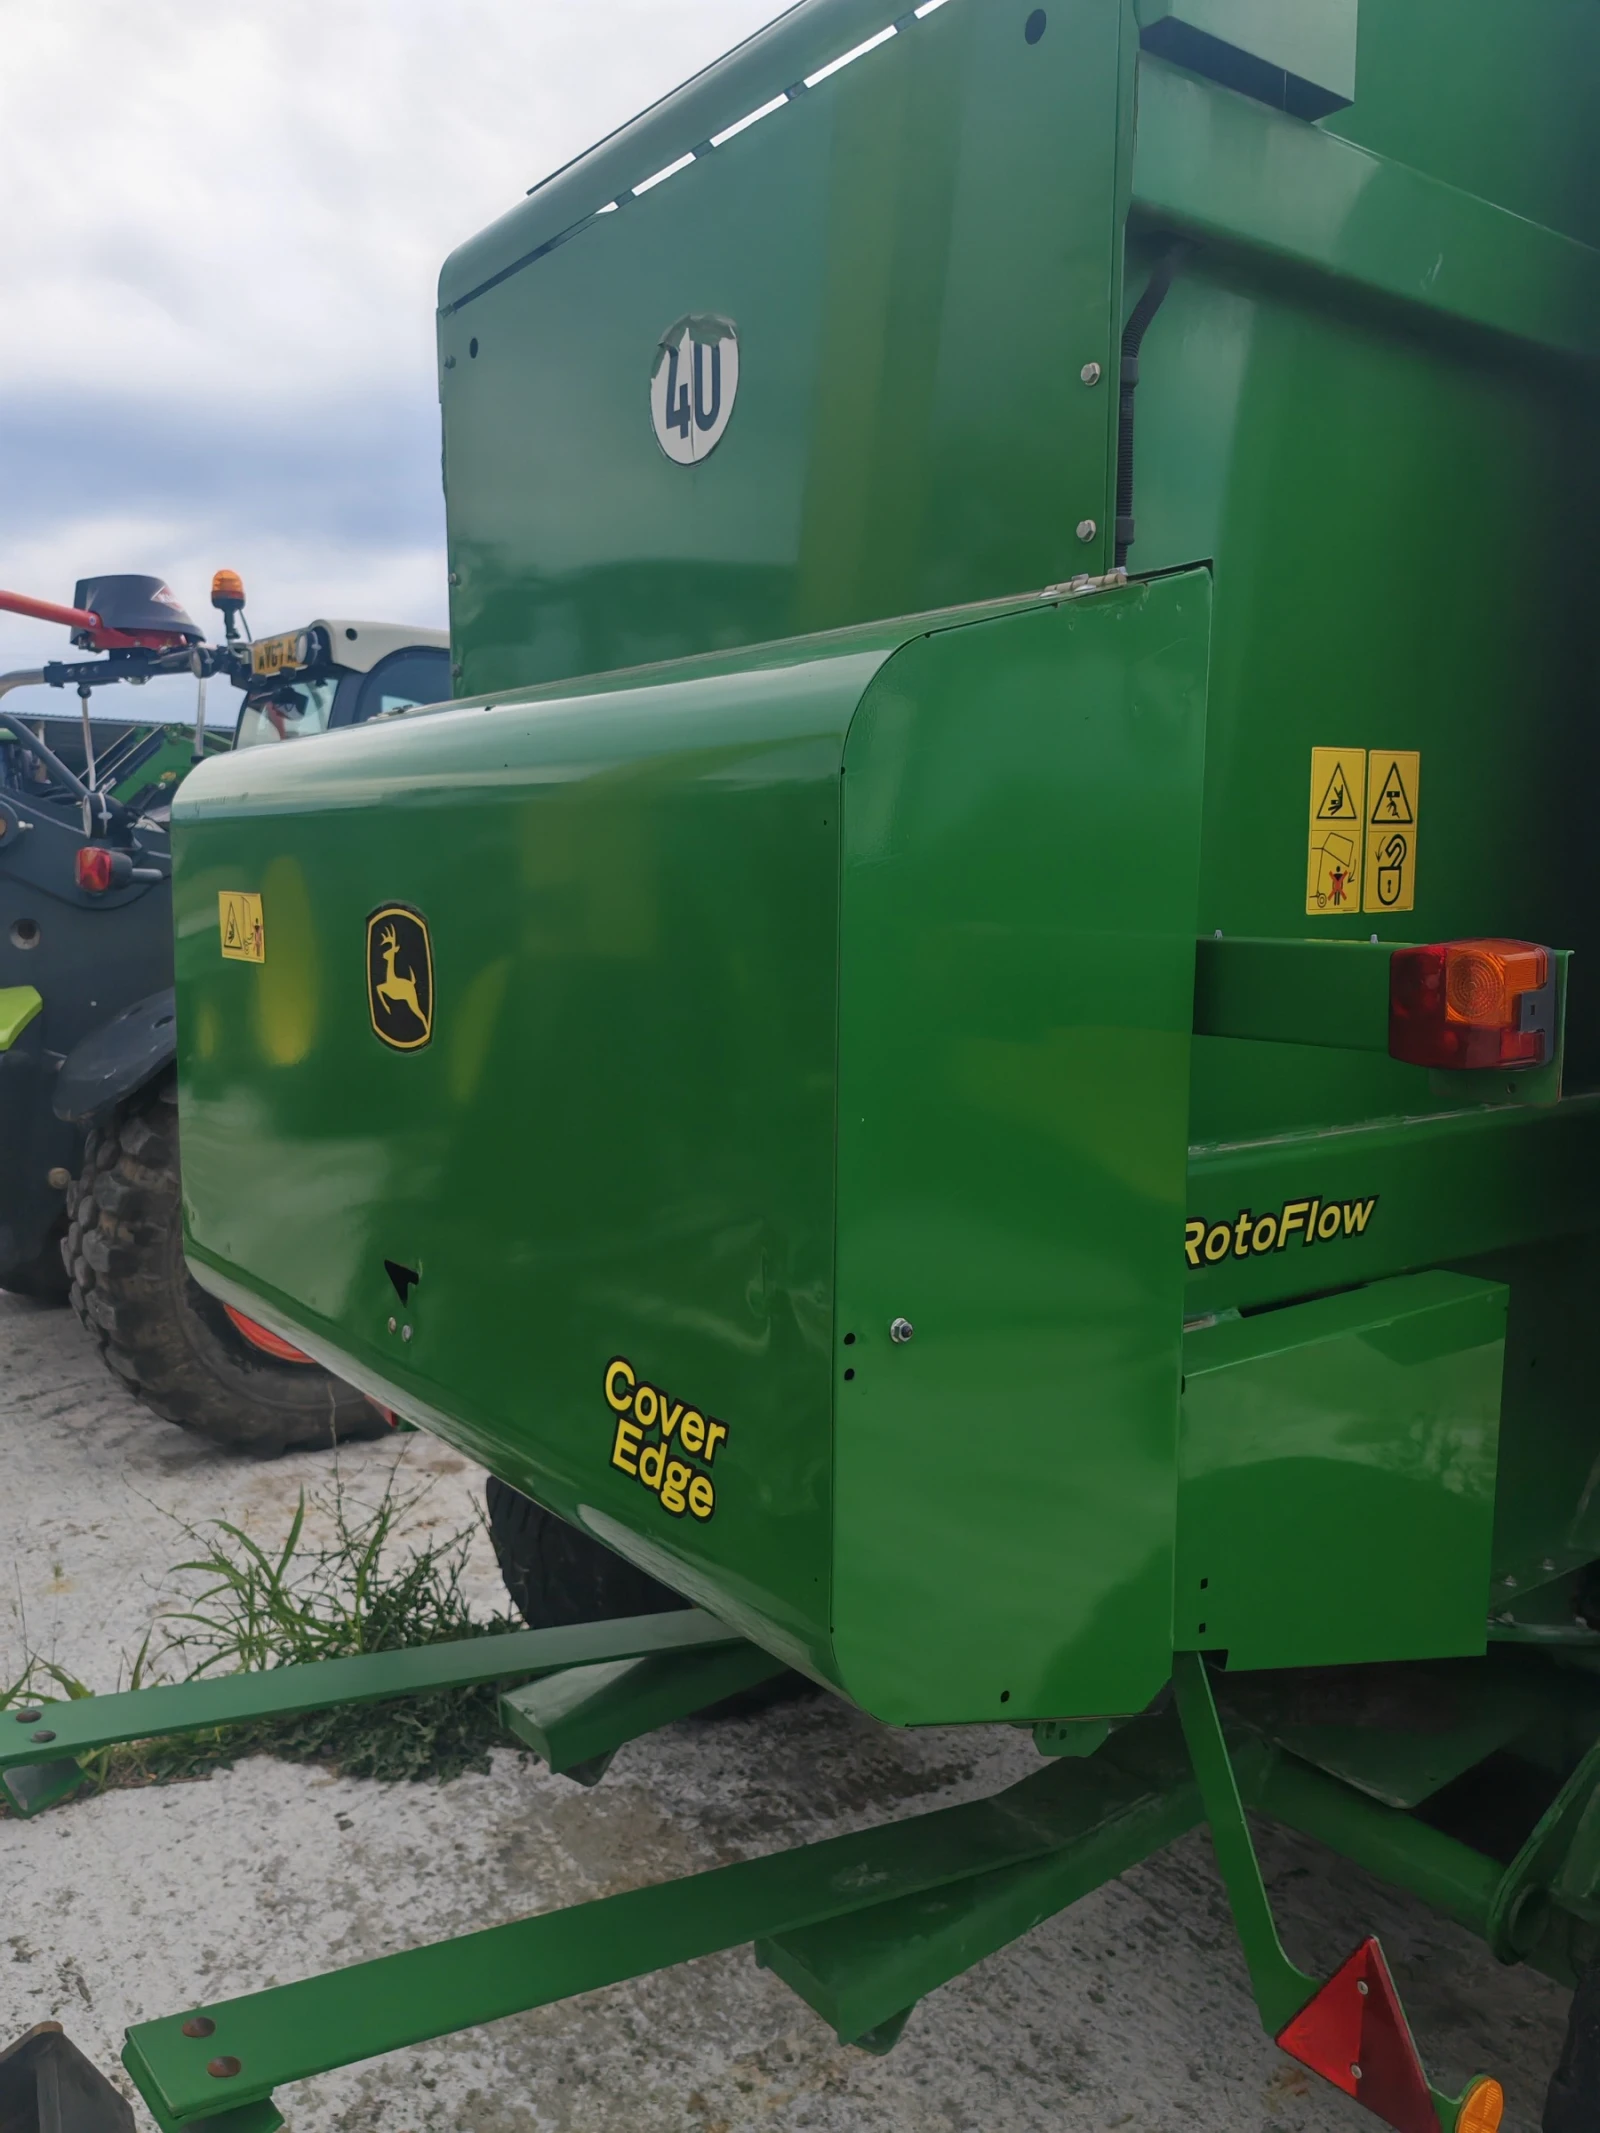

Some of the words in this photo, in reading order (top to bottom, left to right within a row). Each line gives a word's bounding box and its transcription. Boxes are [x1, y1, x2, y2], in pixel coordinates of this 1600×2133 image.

[1184, 1198, 1376, 1266] RotoFlow
[604, 1360, 727, 1462] Cover
[612, 1418, 714, 1518] Edge
